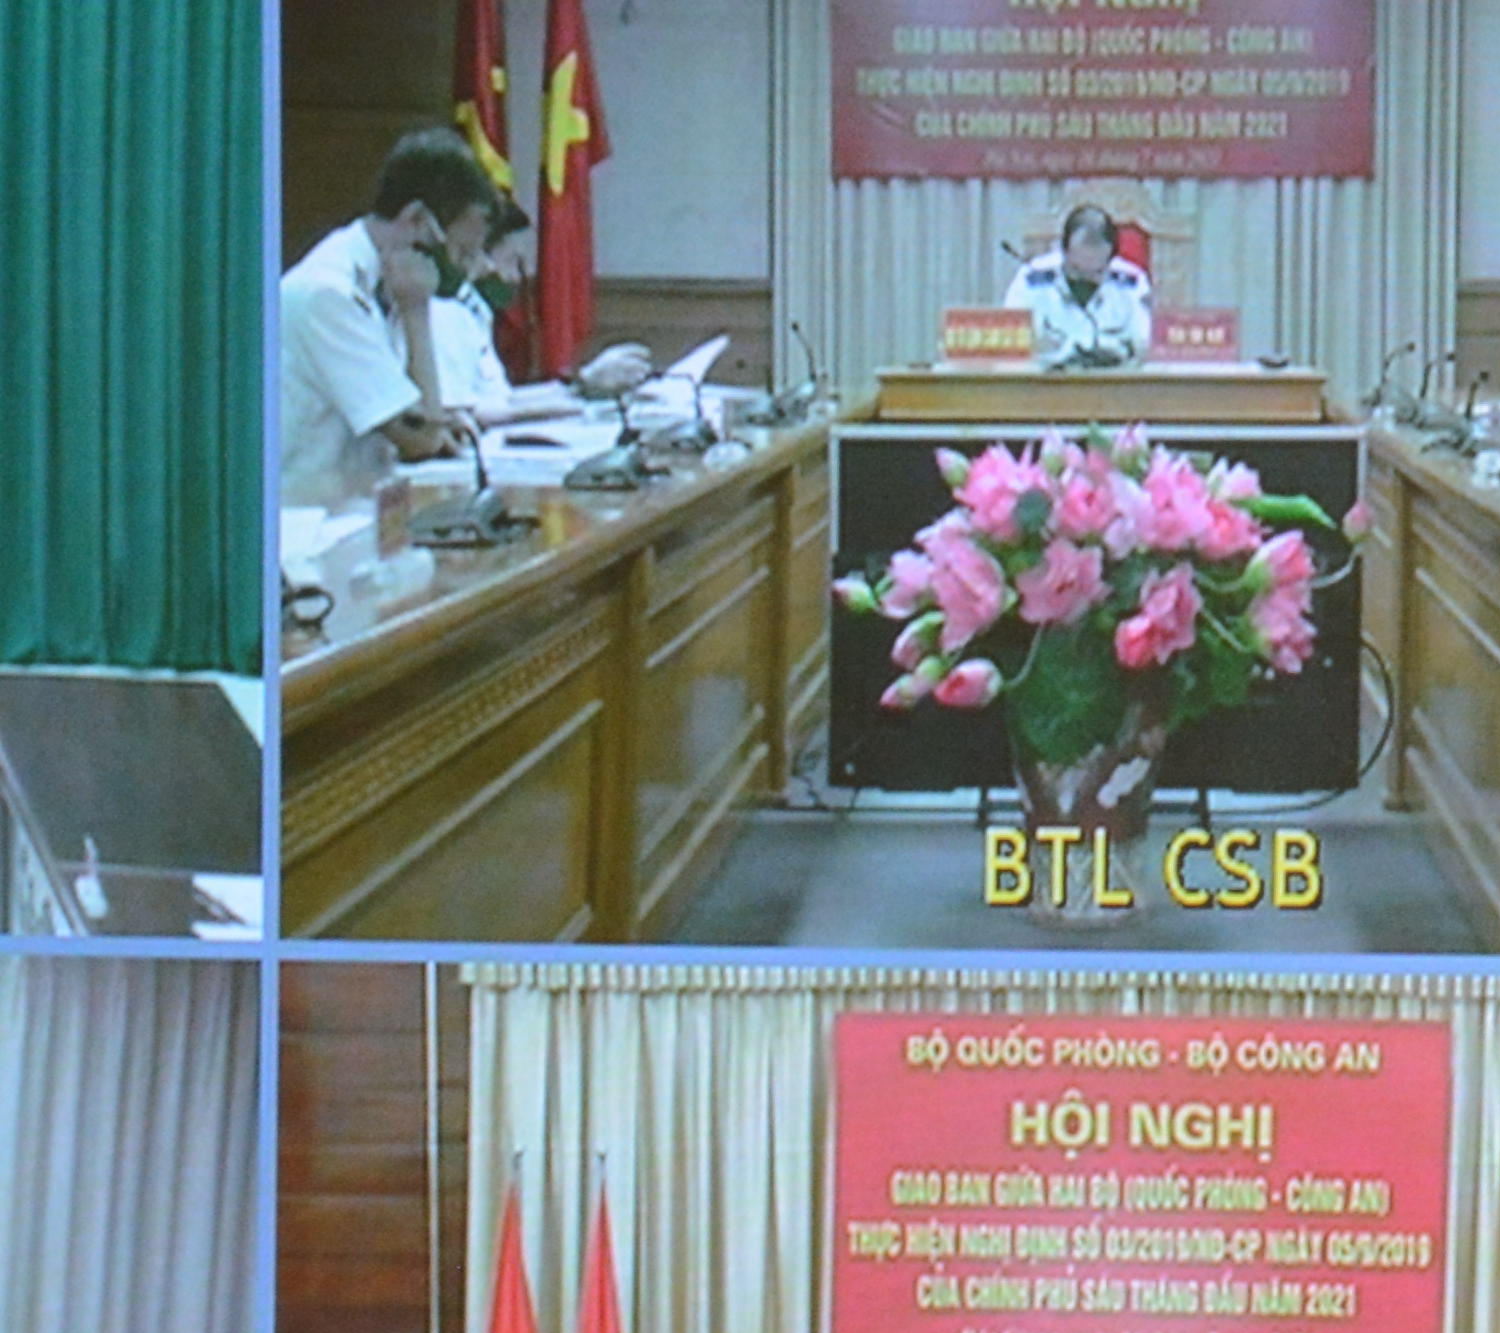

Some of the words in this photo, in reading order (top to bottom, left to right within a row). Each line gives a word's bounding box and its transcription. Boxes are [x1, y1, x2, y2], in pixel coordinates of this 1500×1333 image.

[985, 827, 1134, 906] BTL
[1163, 827, 1322, 907] CSB
[907, 1028, 948, 1072] BỘ
[957, 1023, 1044, 1066] QUỐC
[1187, 1032, 1227, 1076] BỘ
[1239, 1033, 1324, 1071] CÔNG
[1334, 1043, 1379, 1071] AN
[1011, 1089, 1109, 1160] HỘI
[1130, 1103, 1273, 1162] NGHỊ
